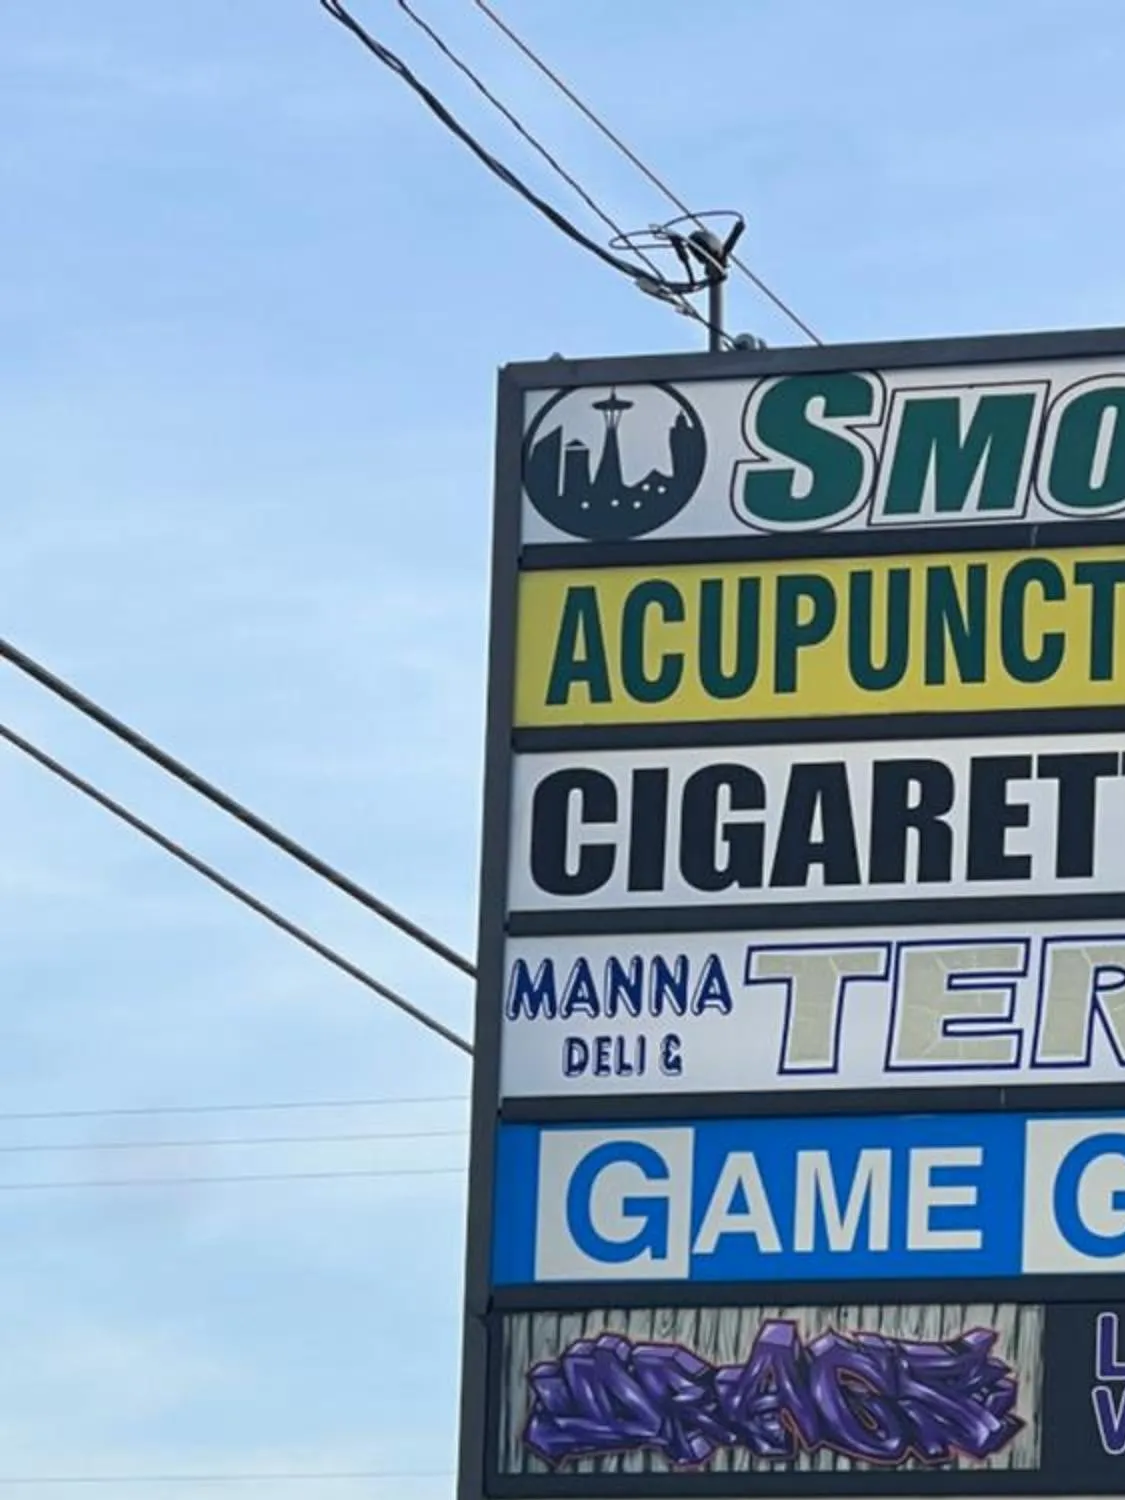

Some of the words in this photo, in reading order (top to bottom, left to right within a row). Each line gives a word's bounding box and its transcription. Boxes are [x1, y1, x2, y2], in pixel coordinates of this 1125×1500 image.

[506, 953, 733, 1021] MANNA
[562, 1034, 647, 1077] DELI
[659, 1032, 683, 1076] &
[564, 1140, 984, 1264] GAME
